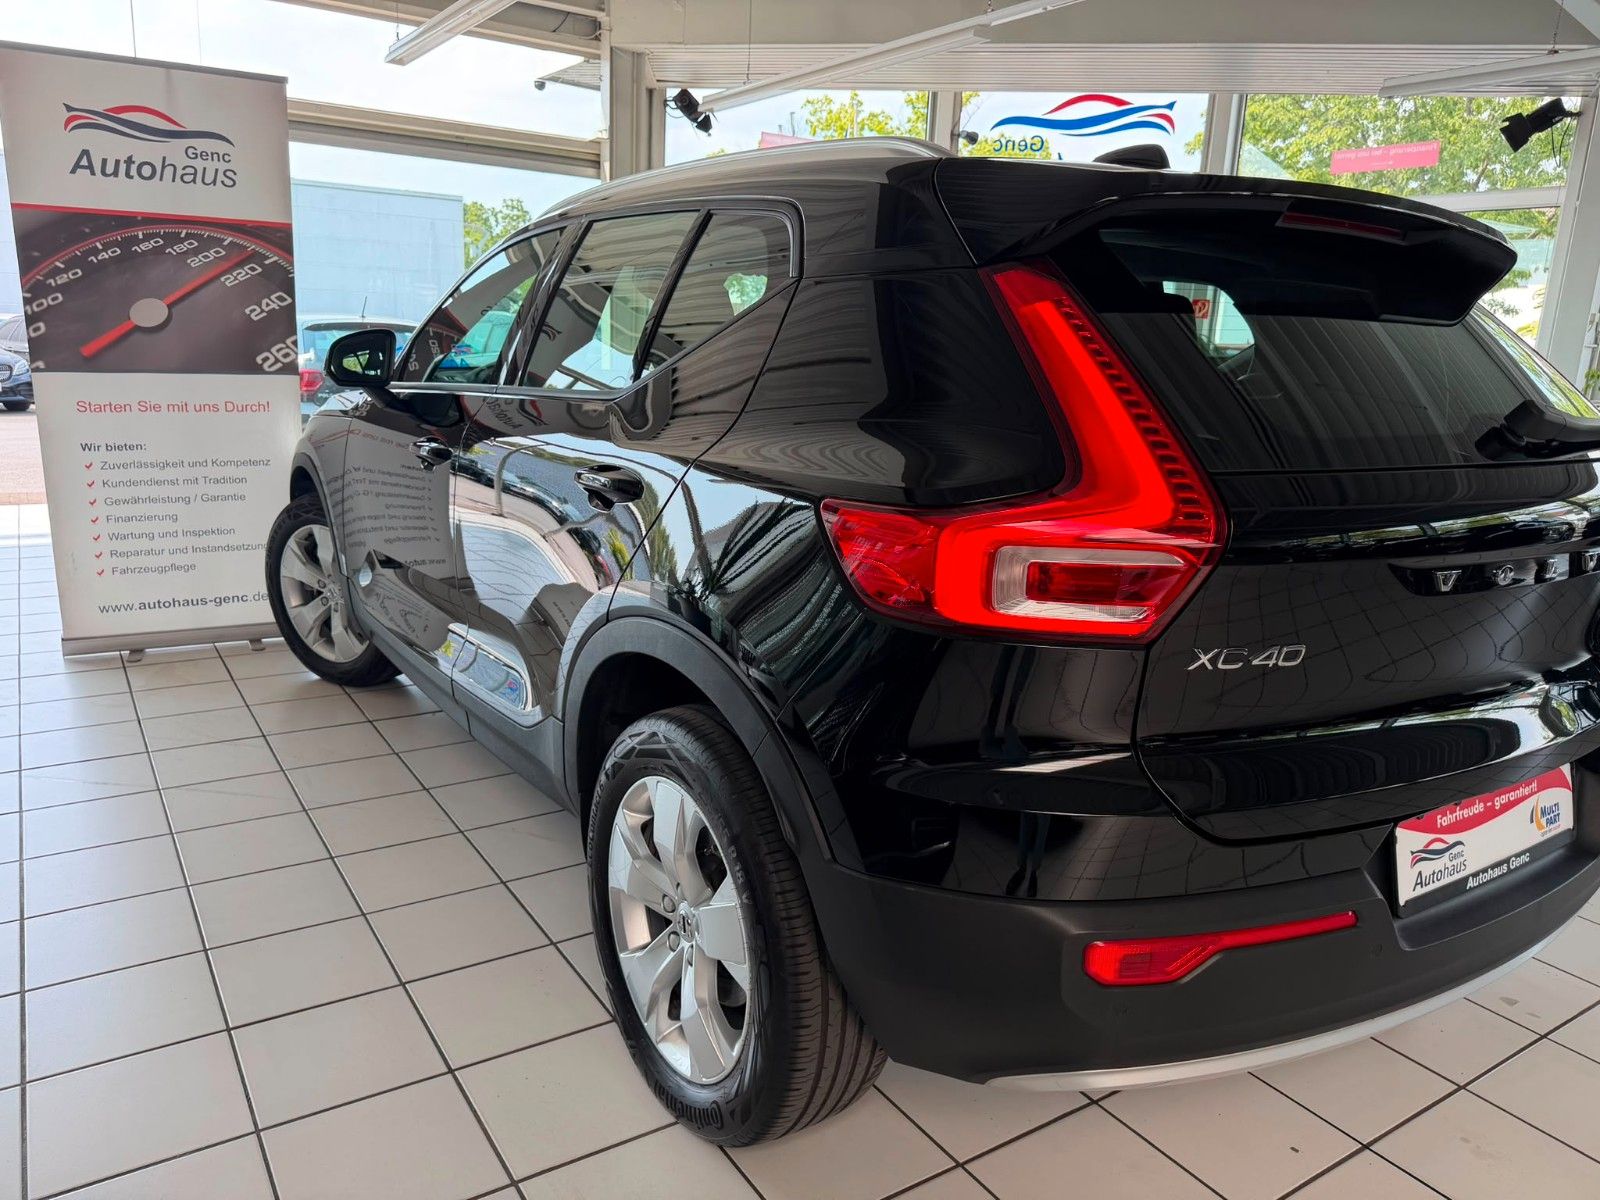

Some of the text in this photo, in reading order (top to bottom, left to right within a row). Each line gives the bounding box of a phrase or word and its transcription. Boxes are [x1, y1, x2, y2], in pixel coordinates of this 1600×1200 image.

[184, 145, 232, 164] Genc
[69, 148, 238, 188] Autohaus
[131, 237, 164, 253] 160
[165, 239, 198, 256] 180
[87, 247, 121, 263] 140
[187, 247, 226, 268] 200
[46, 268, 82, 287] 120
[220, 263, 262, 287] 220
[24, 292, 63, 315] 100
[244, 291, 293, 321] 240
[76, 400, 270, 413] Starten Sie mit uns Durch!
[80, 442, 147, 452] Wir bieten:
[100, 457, 271, 471] Zuverlässigkeit und Kompetenz
[102, 475, 248, 488] Kundendienst mit Tradition
[104, 494, 191, 507] Gewährleistung
[200, 493, 247, 503] Garantie
[106, 513, 178, 525] Finanzierung
[107, 527, 235, 543] Wartung und Inspektion
[110, 548, 165, 561] Reparatur
[168, 545, 189, 556] und
[111, 563, 197, 577] Fahrzeugpflege
[98, 591, 269, 614] www.autohaus-genc.de
[1436, 801, 1485, 829] Fahrfreude
[1494, 779, 1538, 810] garantiert!
[1545, 813, 1561, 828] PART
[1448, 849, 1465, 862] Genc
[1412, 858, 1467, 892] Autohaus
[1466, 852, 1530, 890] Autohaus Genc
